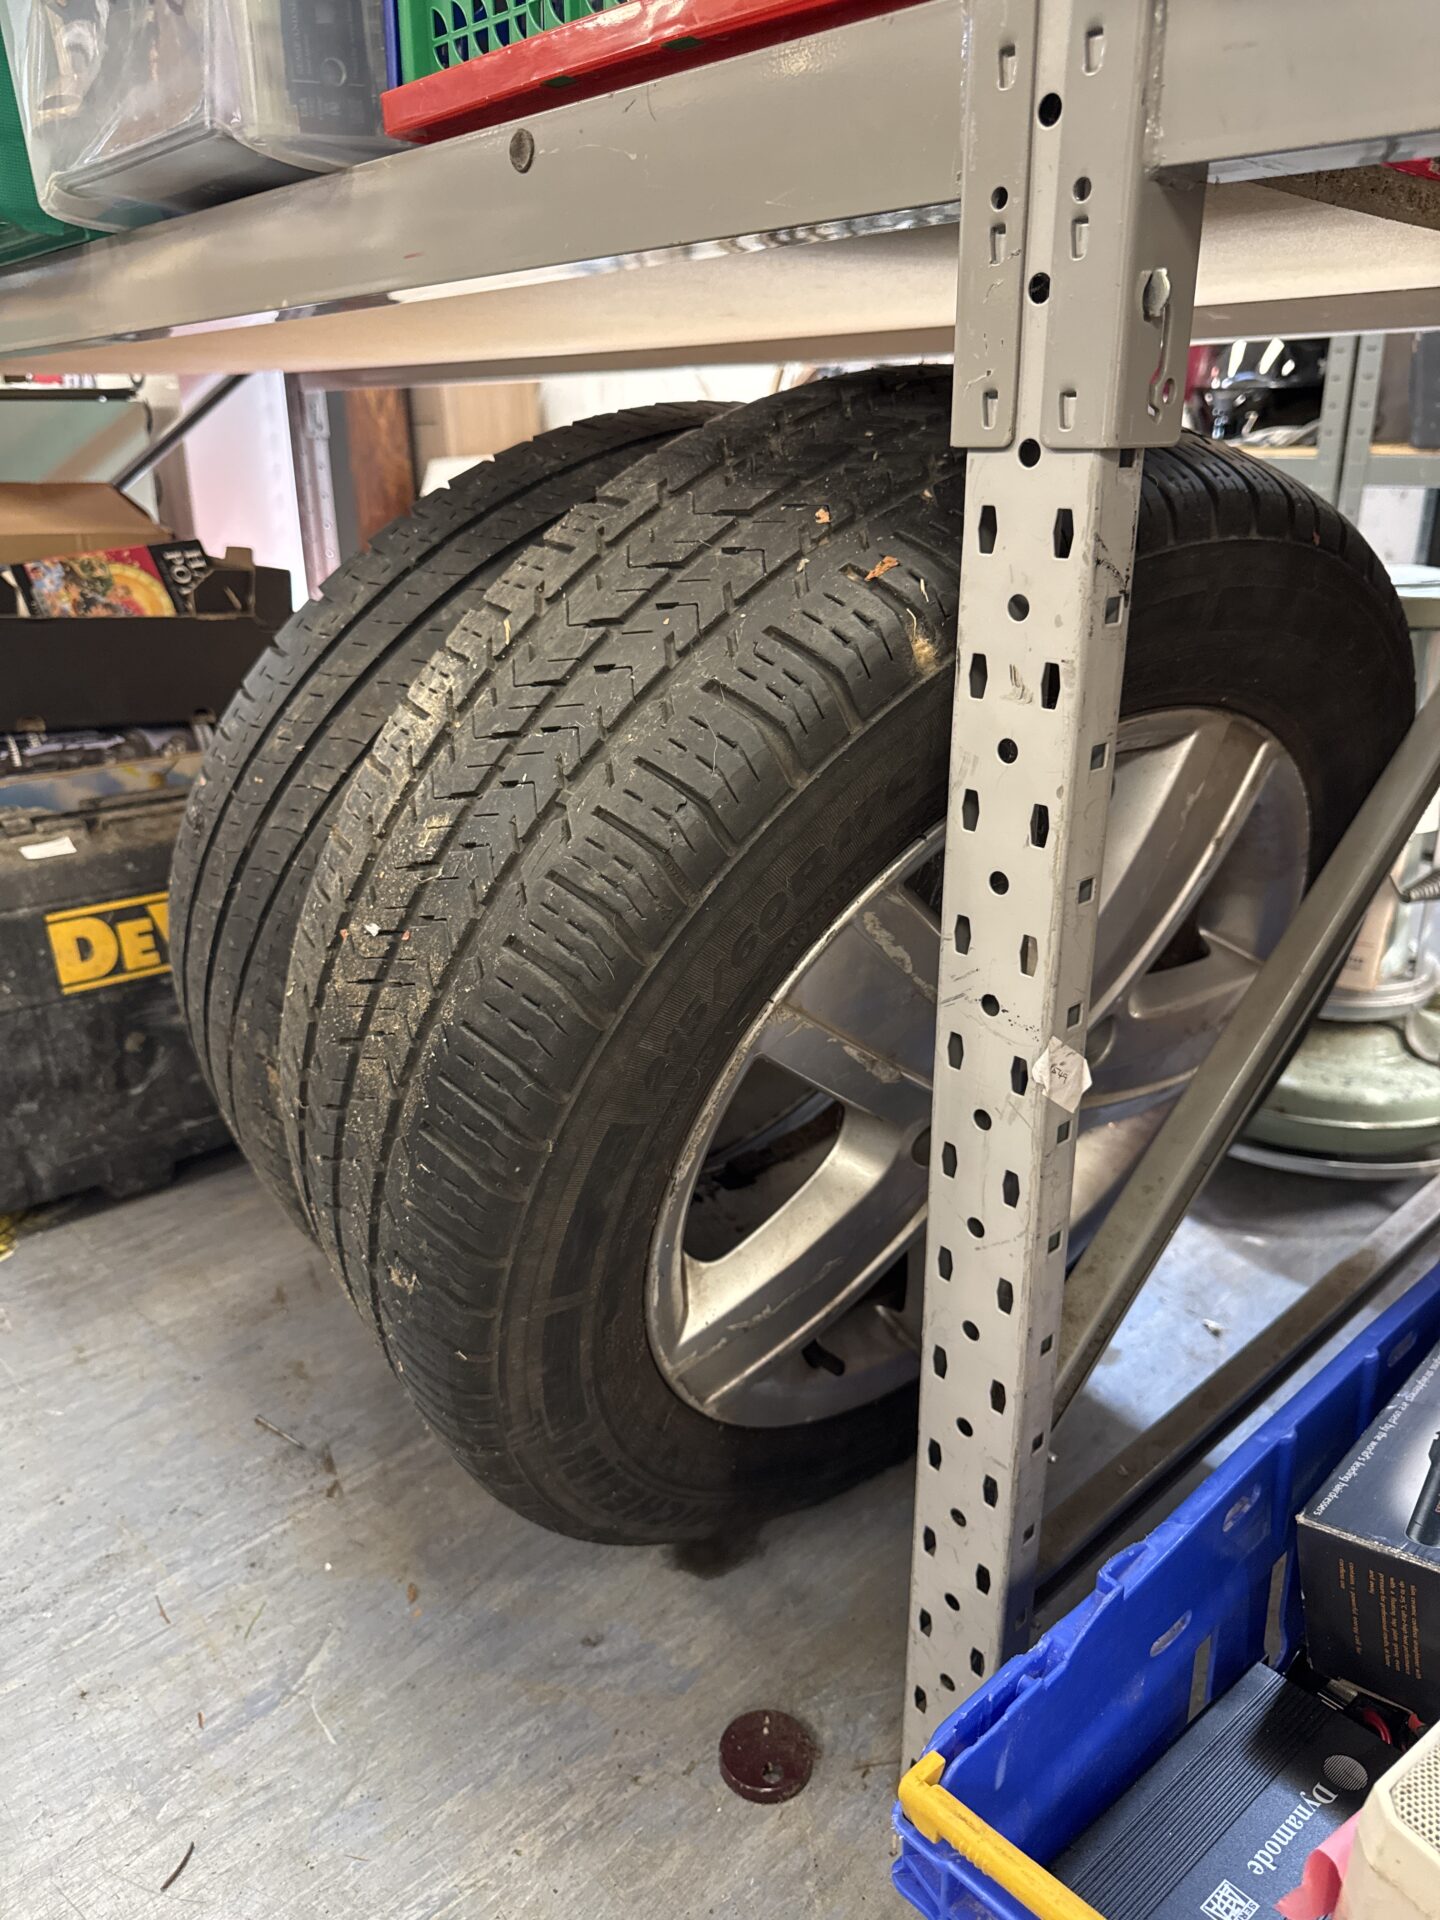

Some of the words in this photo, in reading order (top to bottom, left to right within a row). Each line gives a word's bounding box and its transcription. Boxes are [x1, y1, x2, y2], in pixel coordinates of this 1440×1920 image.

[1339, 1457, 1366, 1485] leading
[1313, 1479, 1349, 1516] hairdressers
[1247, 1782, 1338, 1875] Dynamode
